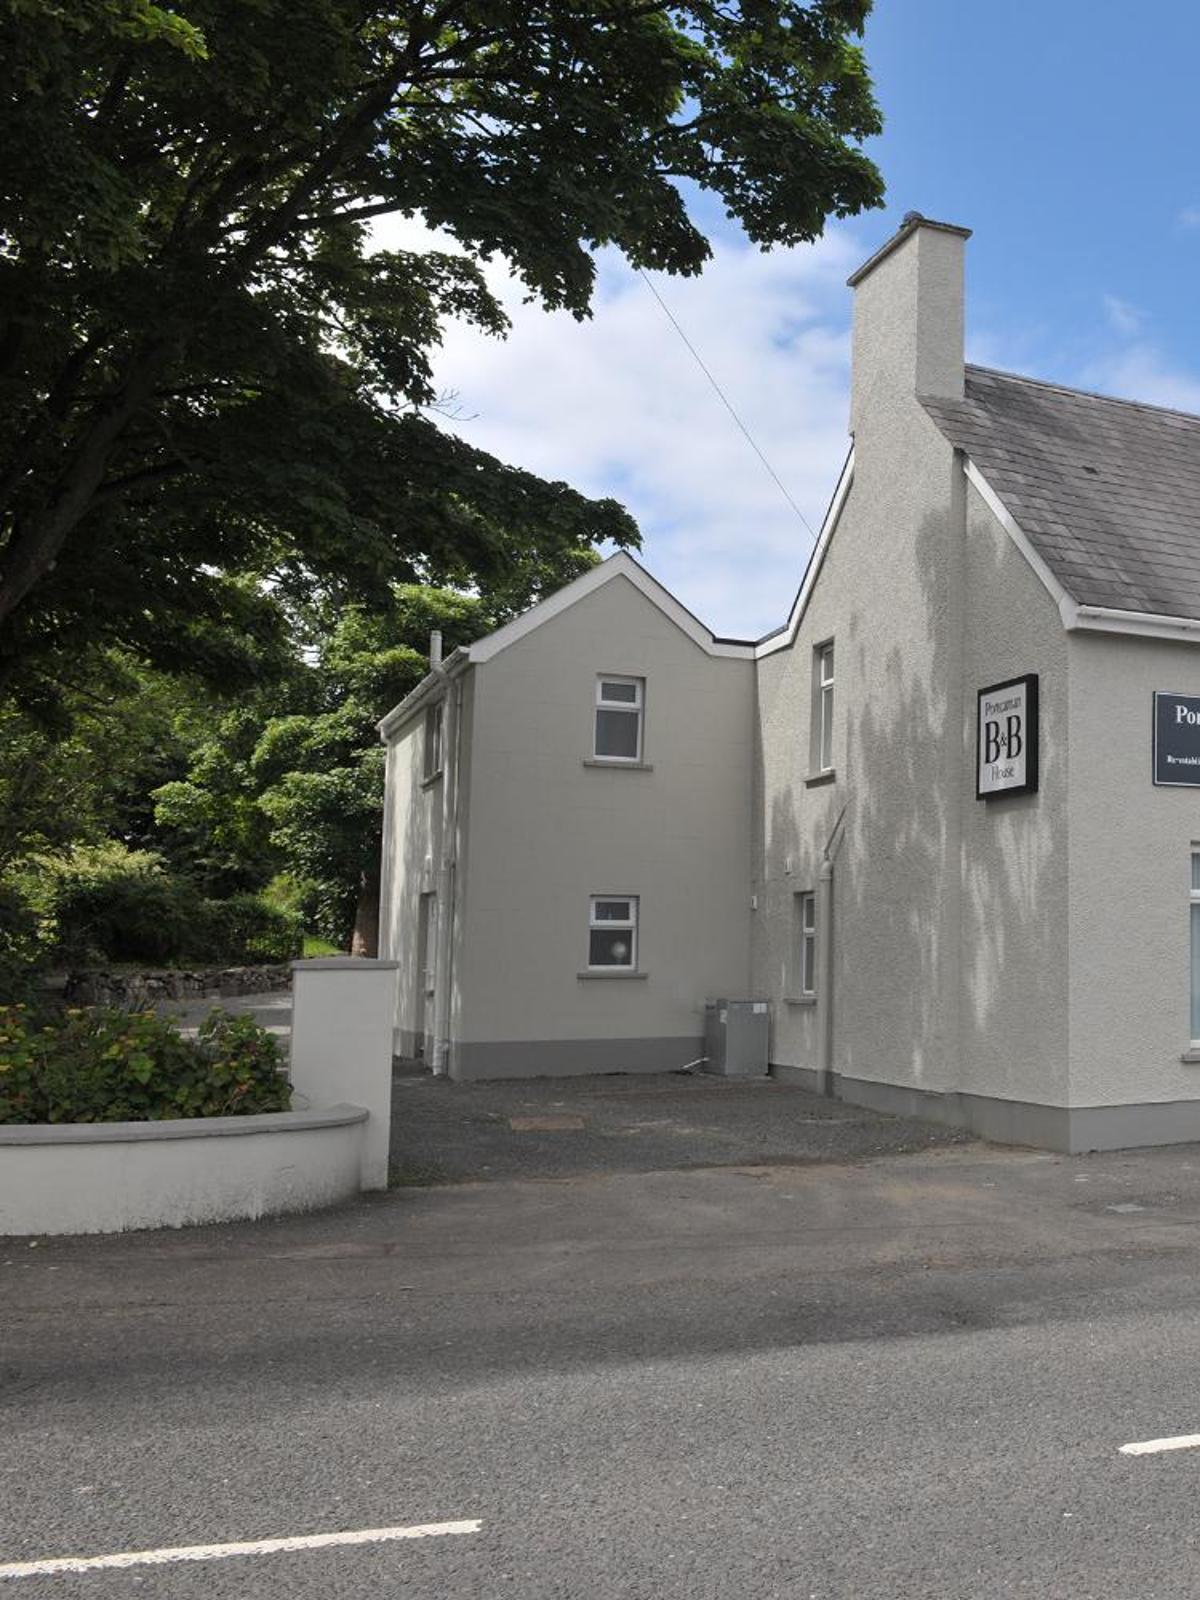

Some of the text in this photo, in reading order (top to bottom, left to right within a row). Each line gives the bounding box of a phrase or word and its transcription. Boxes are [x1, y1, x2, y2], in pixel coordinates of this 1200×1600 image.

[985, 697, 1021, 716] Portcaman
[985, 715, 1021, 764] B&B
[991, 764, 1014, 781] House
